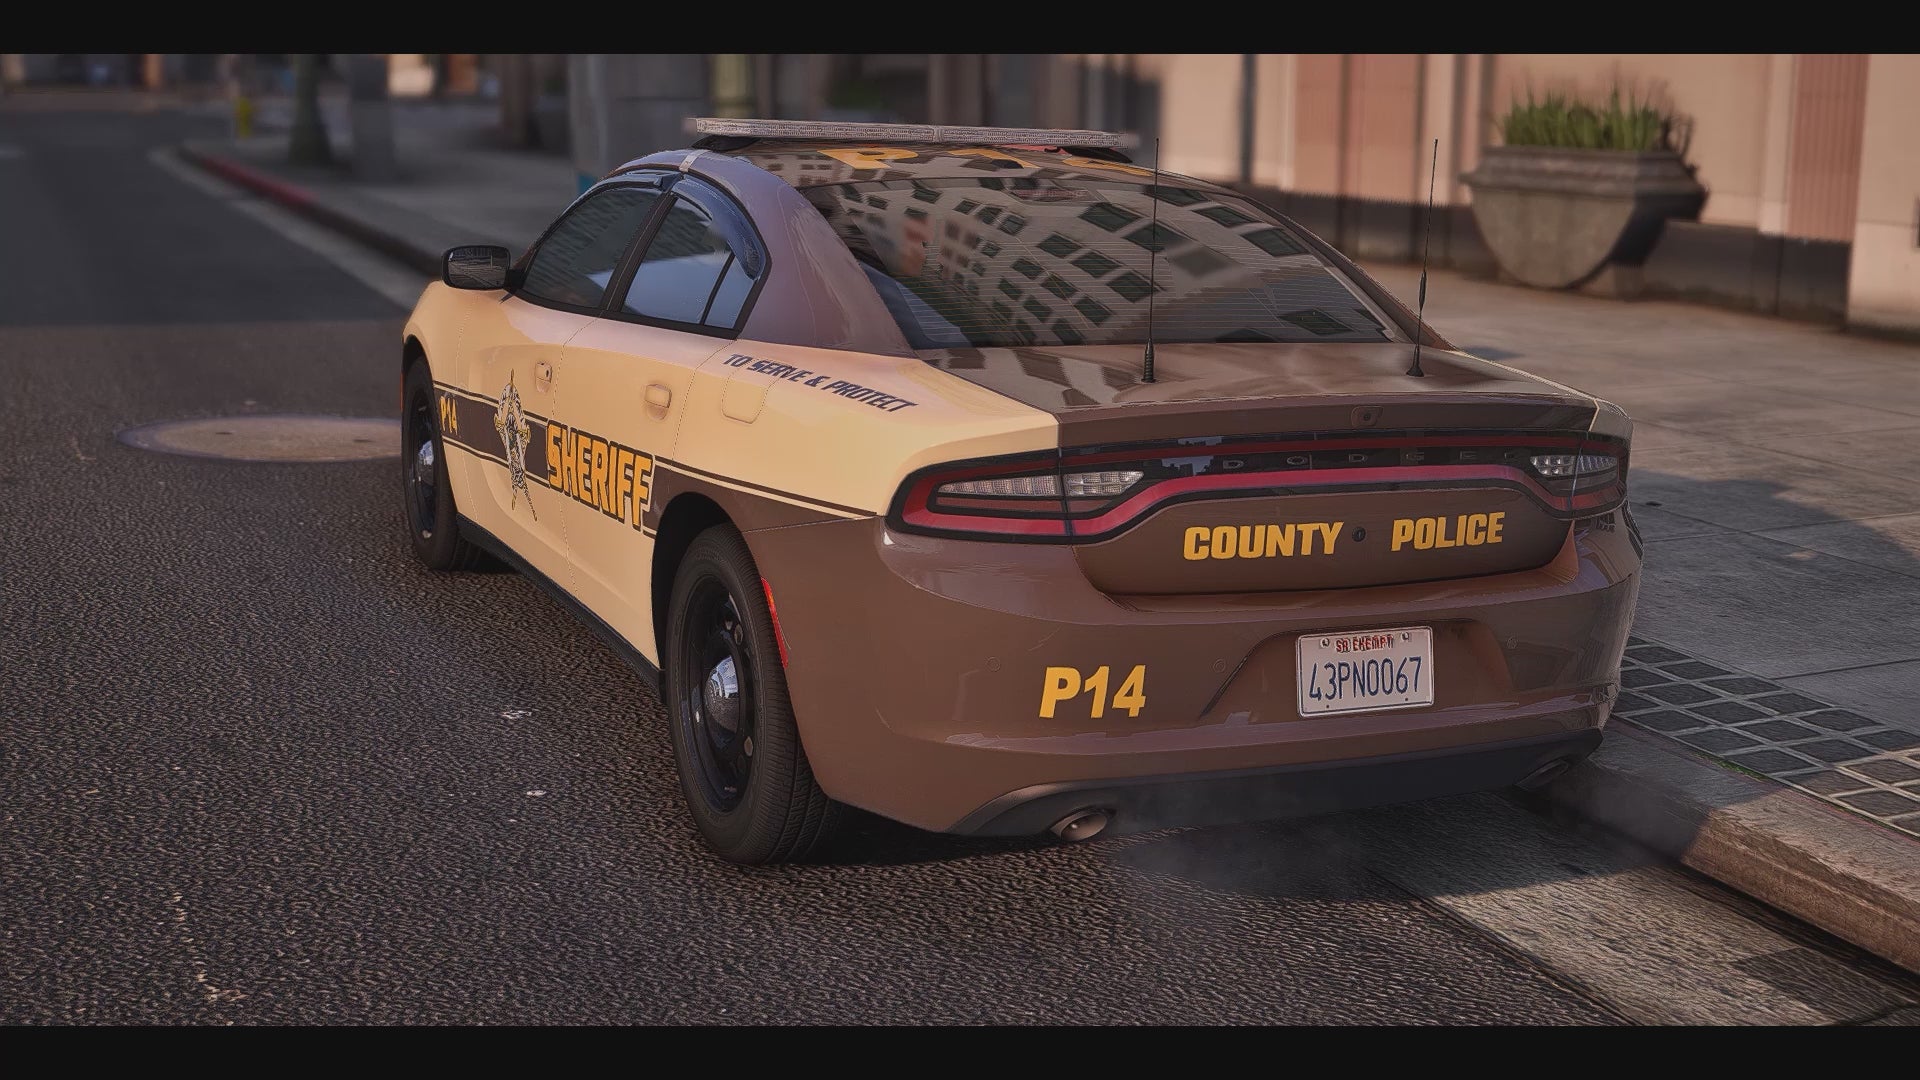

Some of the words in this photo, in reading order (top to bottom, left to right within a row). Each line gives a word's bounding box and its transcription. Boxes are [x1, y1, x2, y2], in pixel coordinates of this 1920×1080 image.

[723, 353, 754, 368] TO
[747, 359, 812, 383] SERVE
[803, 375, 831, 388] &
[821, 379, 919, 412] PROTECT
[439, 395, 458, 435] P14
[546, 419, 654, 531] SHERIFF
[1183, 521, 1345, 560] COUNTY
[1391, 511, 1506, 551] POLICE
[1039, 664, 1147, 718] P14
[1308, 656, 1422, 702] 43PN0067
